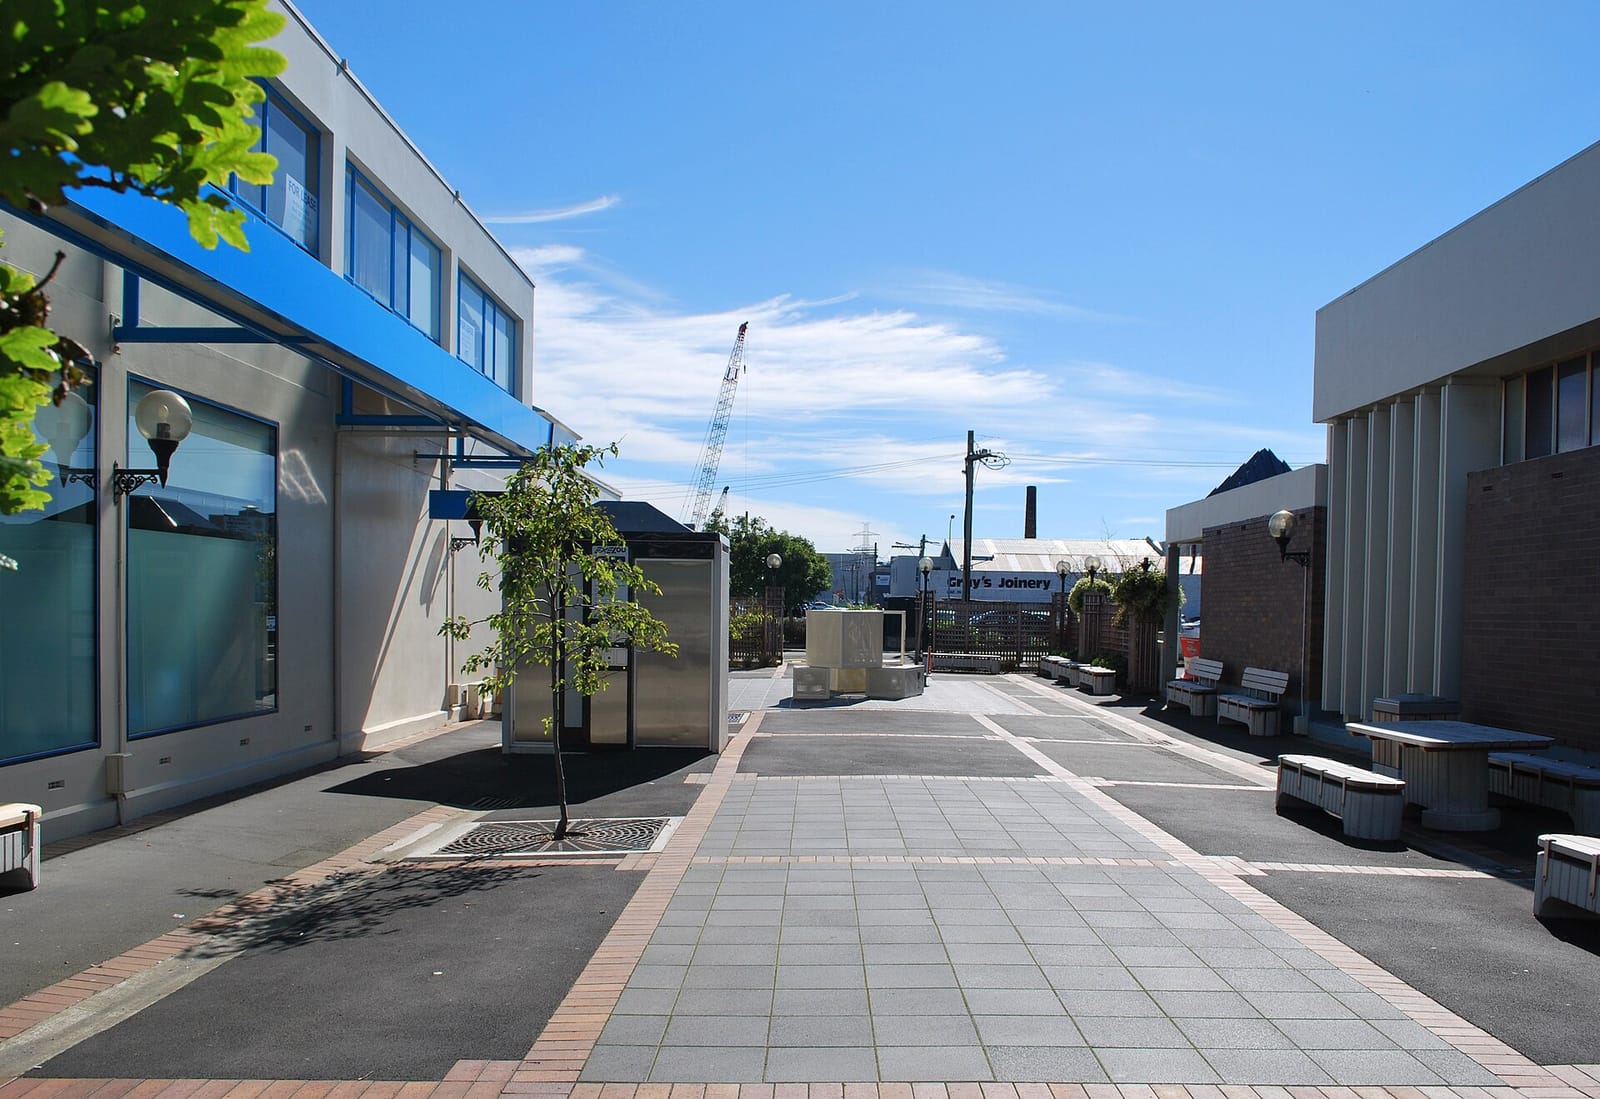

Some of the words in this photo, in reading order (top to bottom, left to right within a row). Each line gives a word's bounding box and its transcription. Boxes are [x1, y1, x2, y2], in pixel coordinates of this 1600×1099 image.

[288, 181, 301, 199] FOR
[300, 188, 317, 212] LEASE
[947, 576, 992, 589] Gry's
[998, 577, 1051, 590] Joinery
